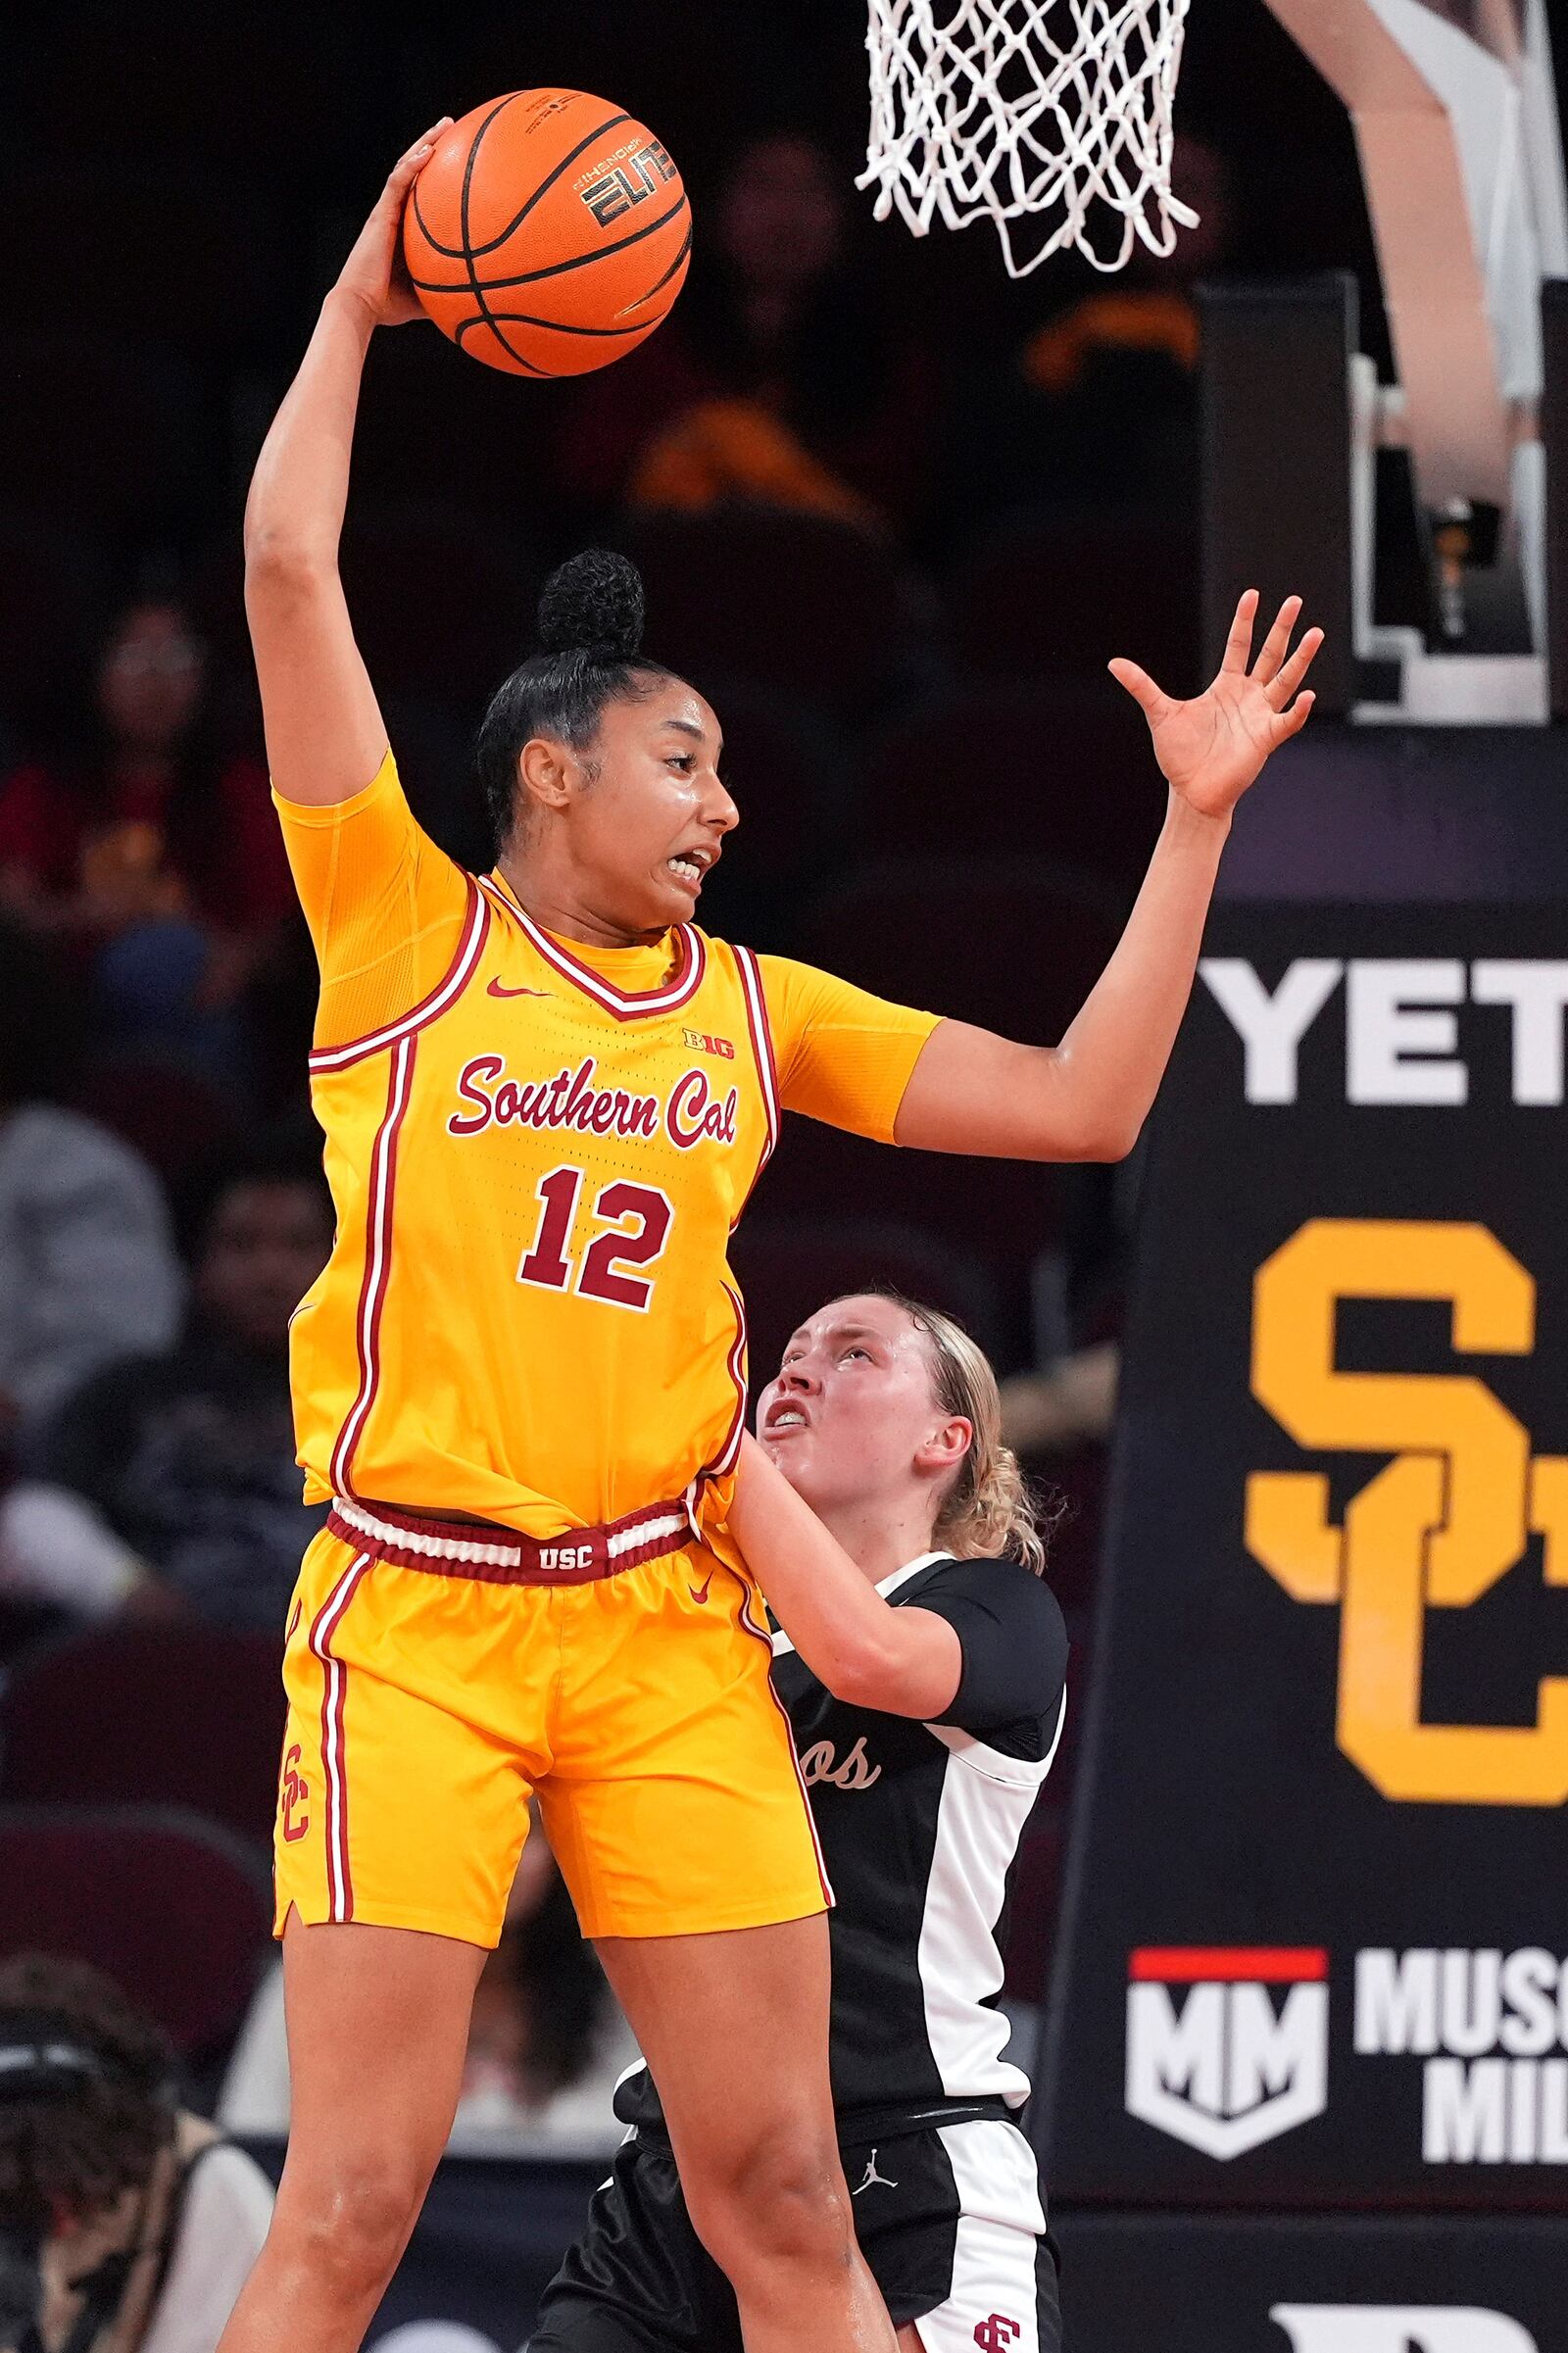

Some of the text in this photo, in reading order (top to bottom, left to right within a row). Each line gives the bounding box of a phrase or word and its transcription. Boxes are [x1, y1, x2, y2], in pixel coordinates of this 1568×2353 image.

[579, 140, 678, 228] ELITE
[1197, 956, 1568, 1106] YET
[447, 1053, 738, 1151] Southern Cal
[515, 1163, 676, 1314] 12
[539, 1544, 593, 1570] USC
[799, 1736, 882, 1790] os
[1353, 1946, 1568, 2057] MUS
[1422, 2057, 1568, 2165] MIL
